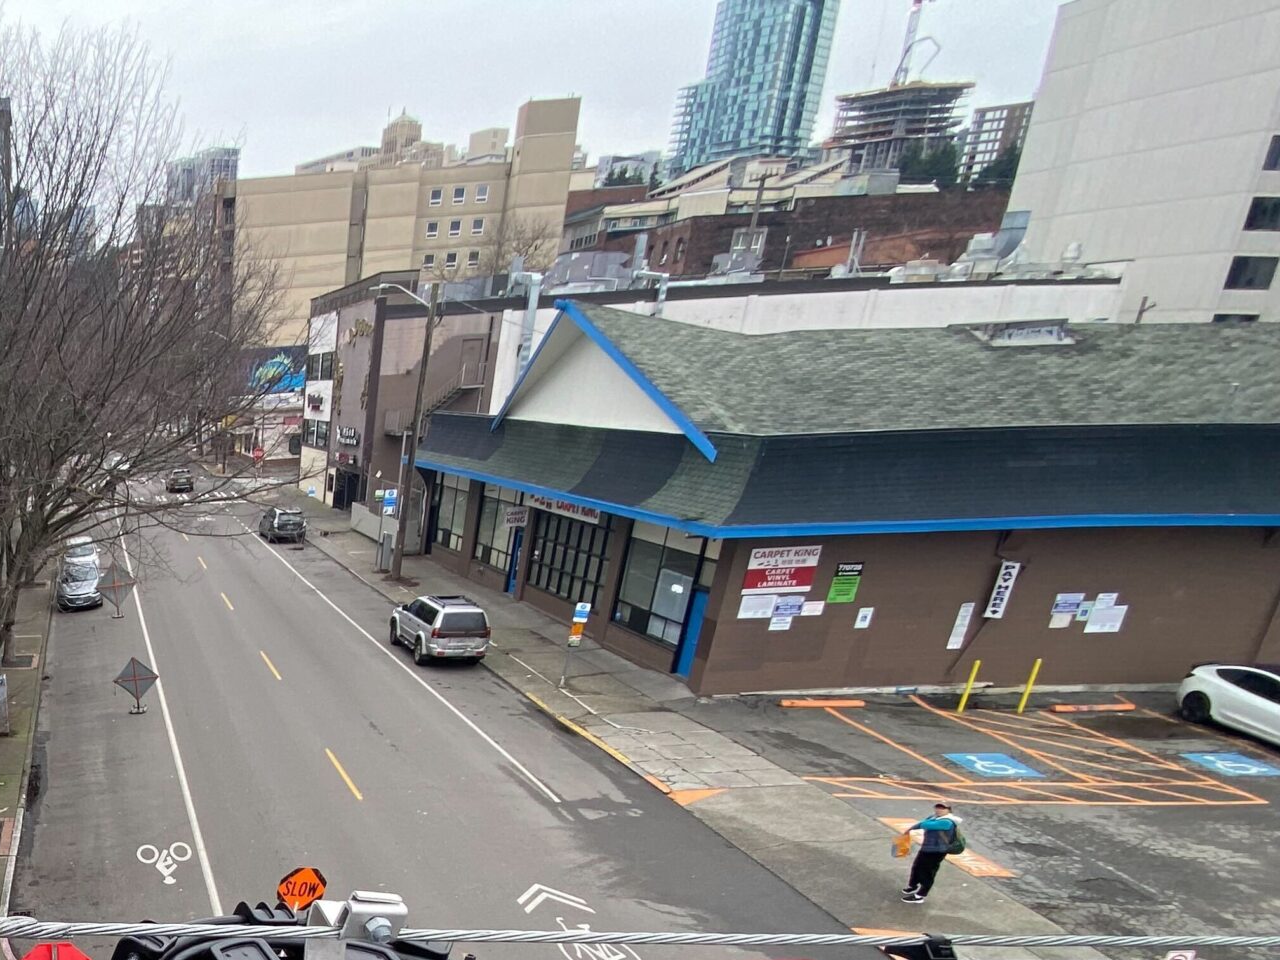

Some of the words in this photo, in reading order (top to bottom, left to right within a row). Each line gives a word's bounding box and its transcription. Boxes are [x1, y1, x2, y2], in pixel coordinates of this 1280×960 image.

[753, 550, 792, 559] CARPET
[765, 568, 795, 576] CARPET
[1001, 565, 1016, 583] PAY
[757, 580, 797, 588] LAMINATE
[991, 585, 1010, 609] HERE
[282, 881, 321, 898] SLOW
